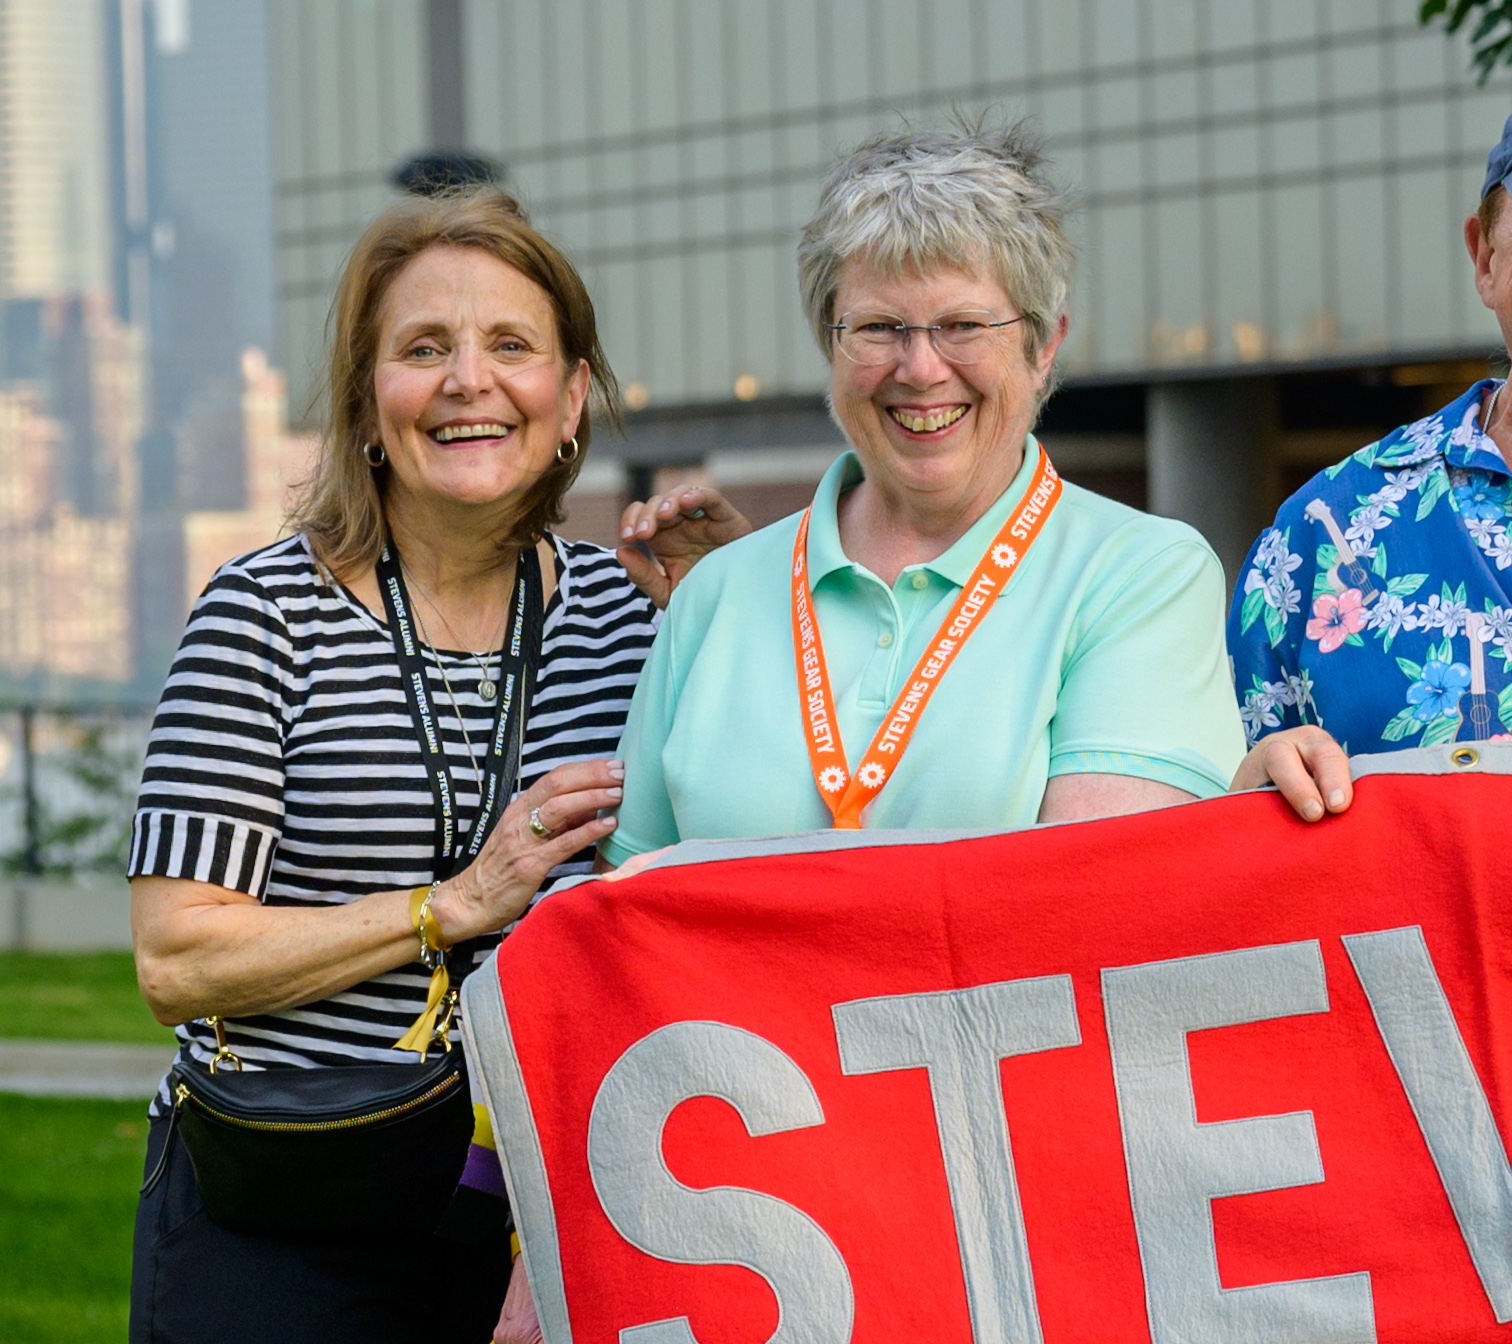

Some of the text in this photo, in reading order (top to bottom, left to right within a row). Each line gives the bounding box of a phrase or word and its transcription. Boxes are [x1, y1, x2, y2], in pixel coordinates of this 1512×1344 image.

[1010, 477, 1056, 541] STEVENS
[387, 576, 416, 656] STEVENS ALUMNI
[511, 616, 525, 657] STEVENS
[795, 580, 835, 754] STEVENS GEAR SOCIETY
[878, 573, 996, 754] STEVENS GEAR SOCIETY
[411, 672, 439, 754] STEVENS ALUMNI
[494, 674, 515, 756] STEVENS ALUMNI
[437, 770, 453, 857] STEVENS ALUMNI
[469, 773, 497, 855] STEVENS ALUMNI
